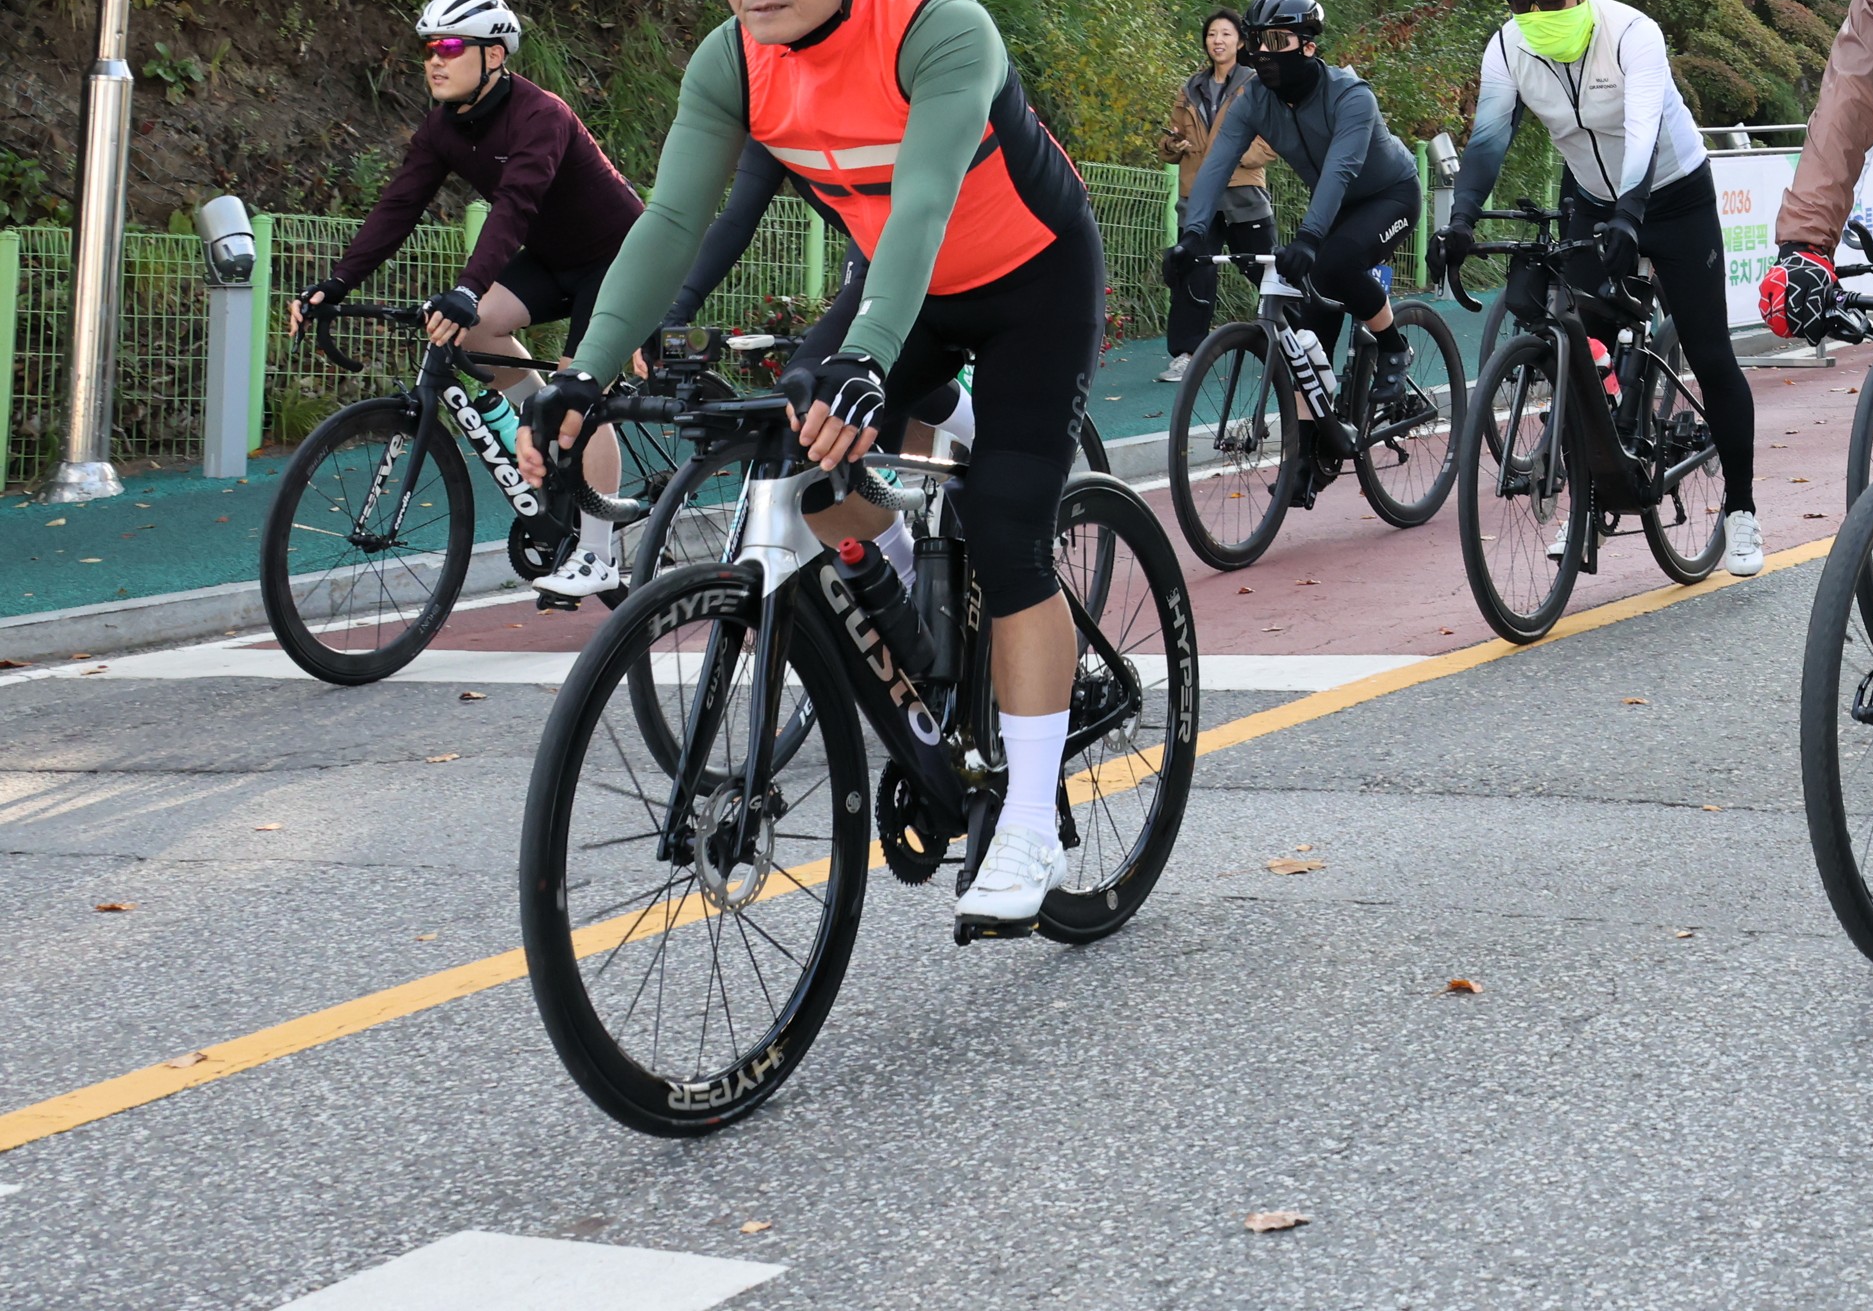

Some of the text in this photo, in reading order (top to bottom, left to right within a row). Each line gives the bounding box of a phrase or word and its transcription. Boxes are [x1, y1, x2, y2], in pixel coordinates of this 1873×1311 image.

[1378, 217, 1409, 244] LAMEDA
[1722, 189, 1751, 215] 2036
[1729, 258, 1752, 286] 유치
[1279, 326, 1326, 418] BMC
[819, 564, 941, 746] GUSTO
[1168, 600, 1191, 745] HYPER
[668, 1039, 781, 1111] HYPER
